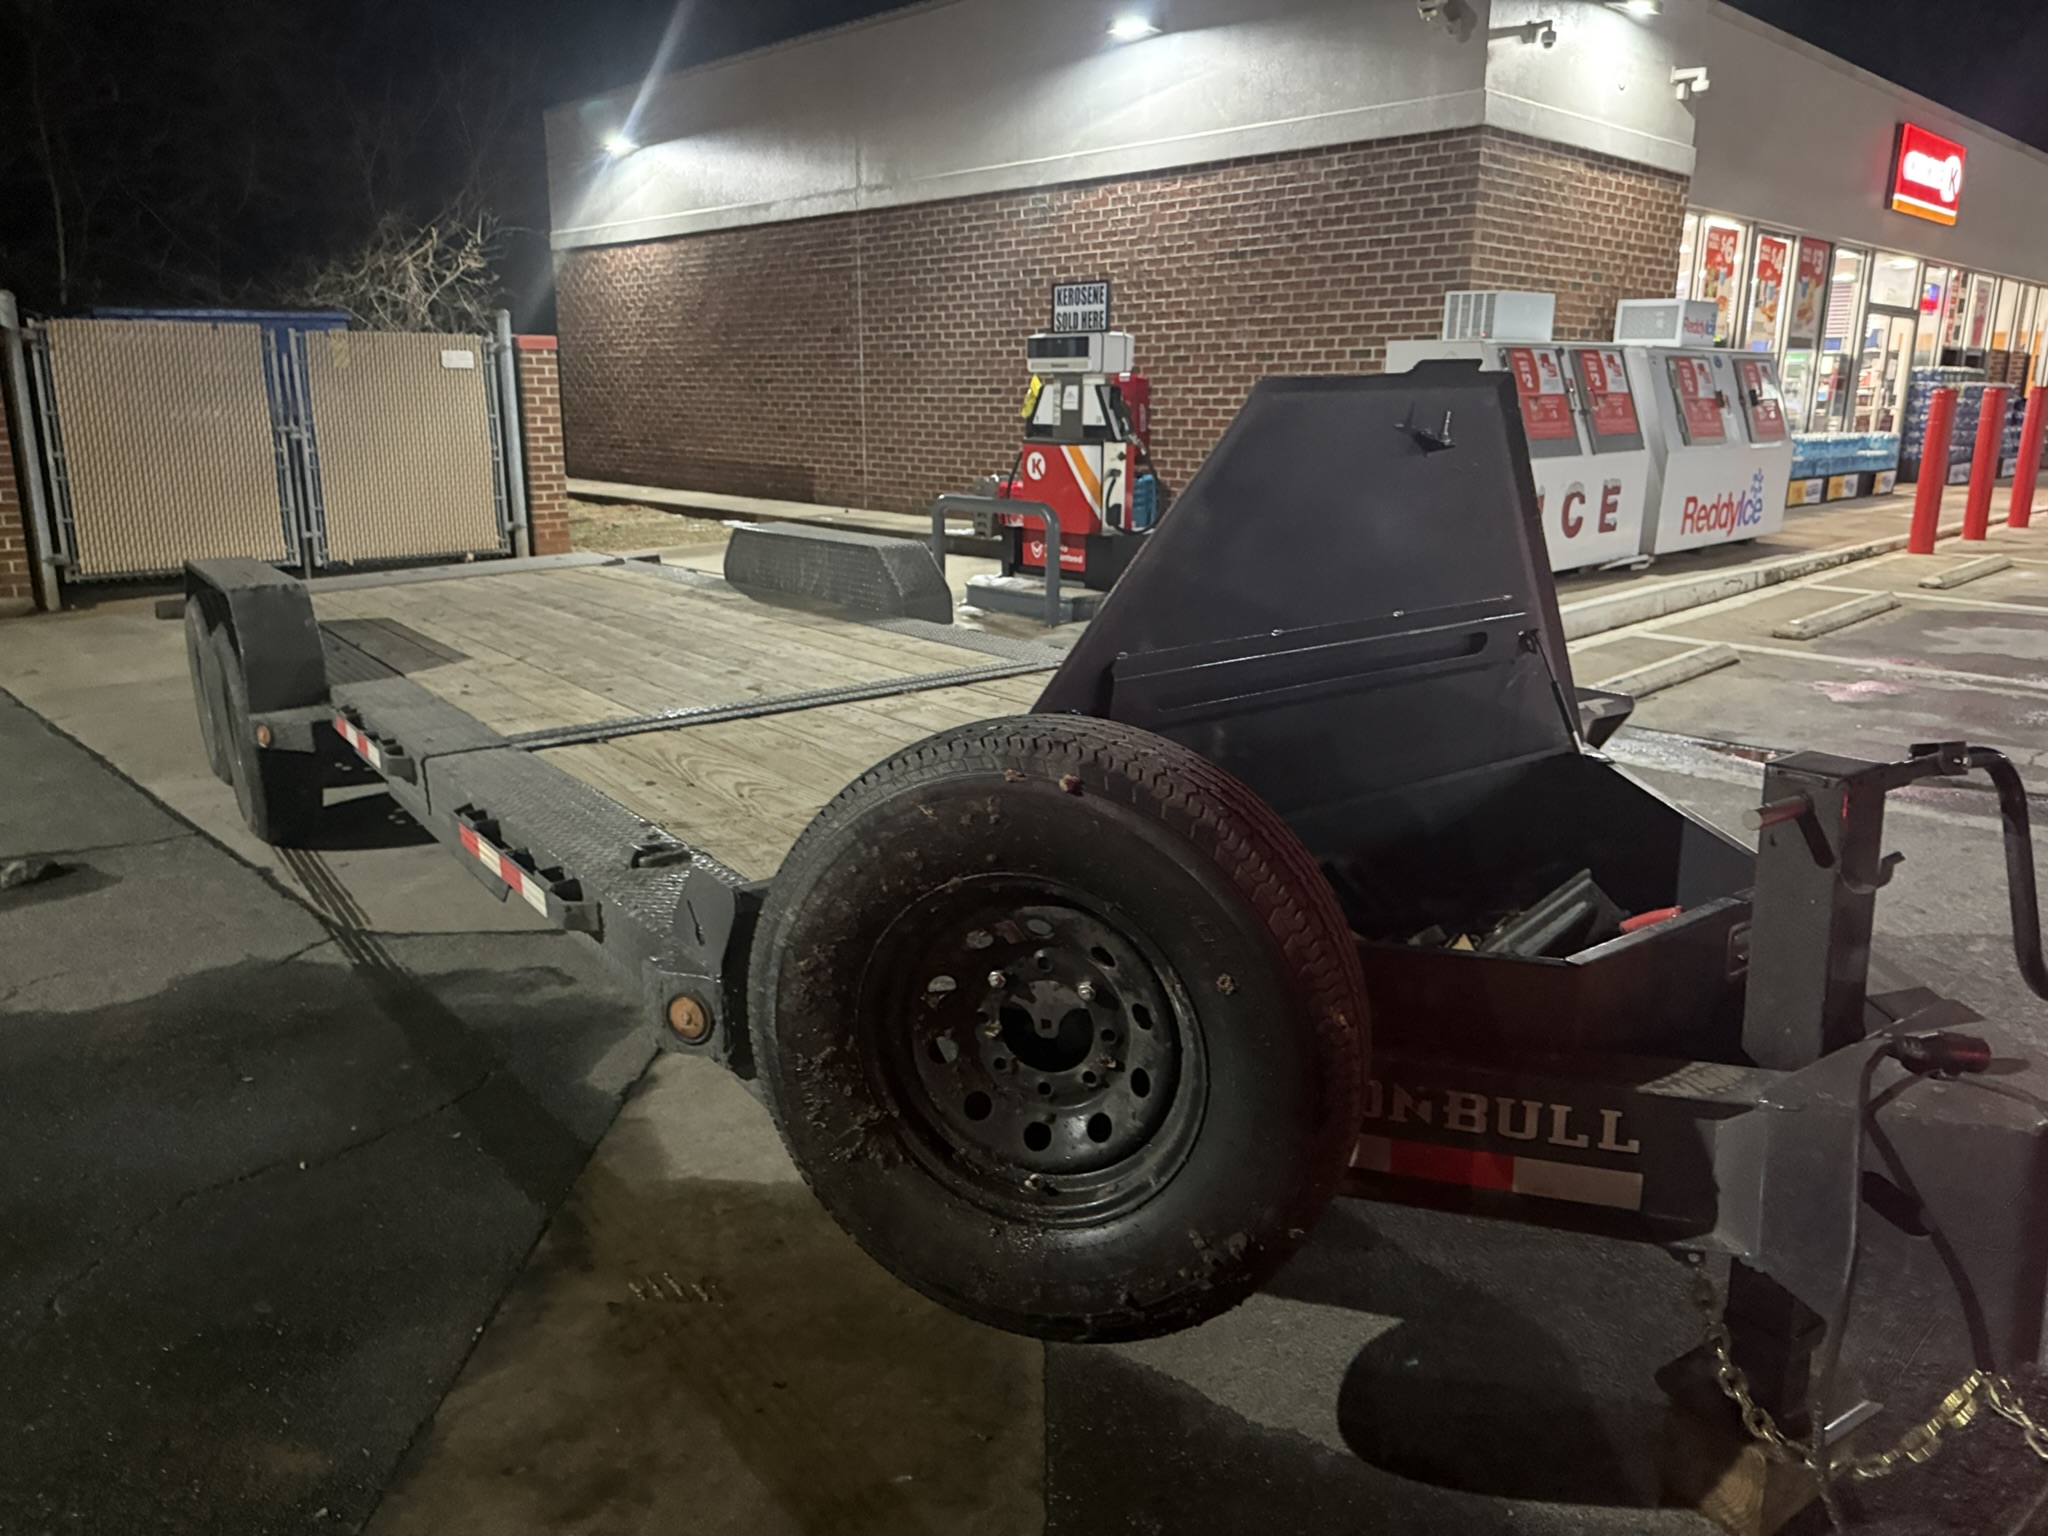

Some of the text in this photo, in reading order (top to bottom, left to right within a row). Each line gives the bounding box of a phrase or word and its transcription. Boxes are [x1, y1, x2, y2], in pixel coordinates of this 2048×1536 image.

[1056, 286, 1104, 306] KEROSENE
[1056, 310, 1104, 330] SOLD HERE
